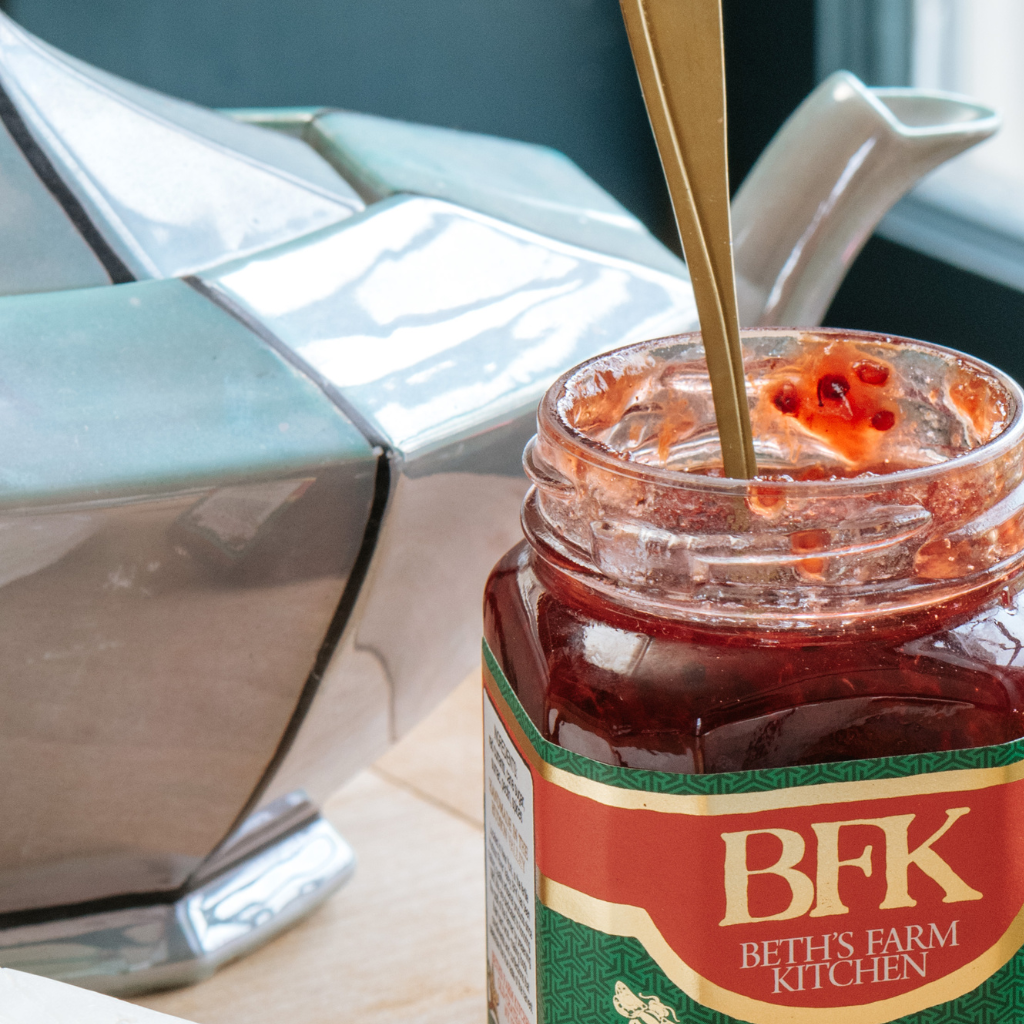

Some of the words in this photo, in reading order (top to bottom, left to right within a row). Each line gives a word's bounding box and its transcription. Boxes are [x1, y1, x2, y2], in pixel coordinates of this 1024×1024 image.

[718, 806, 984, 927] BFK
[739, 931, 855, 969] BETH'S
[866, 920, 960, 956] FARM
[771, 951, 928, 995] KITCHEN
